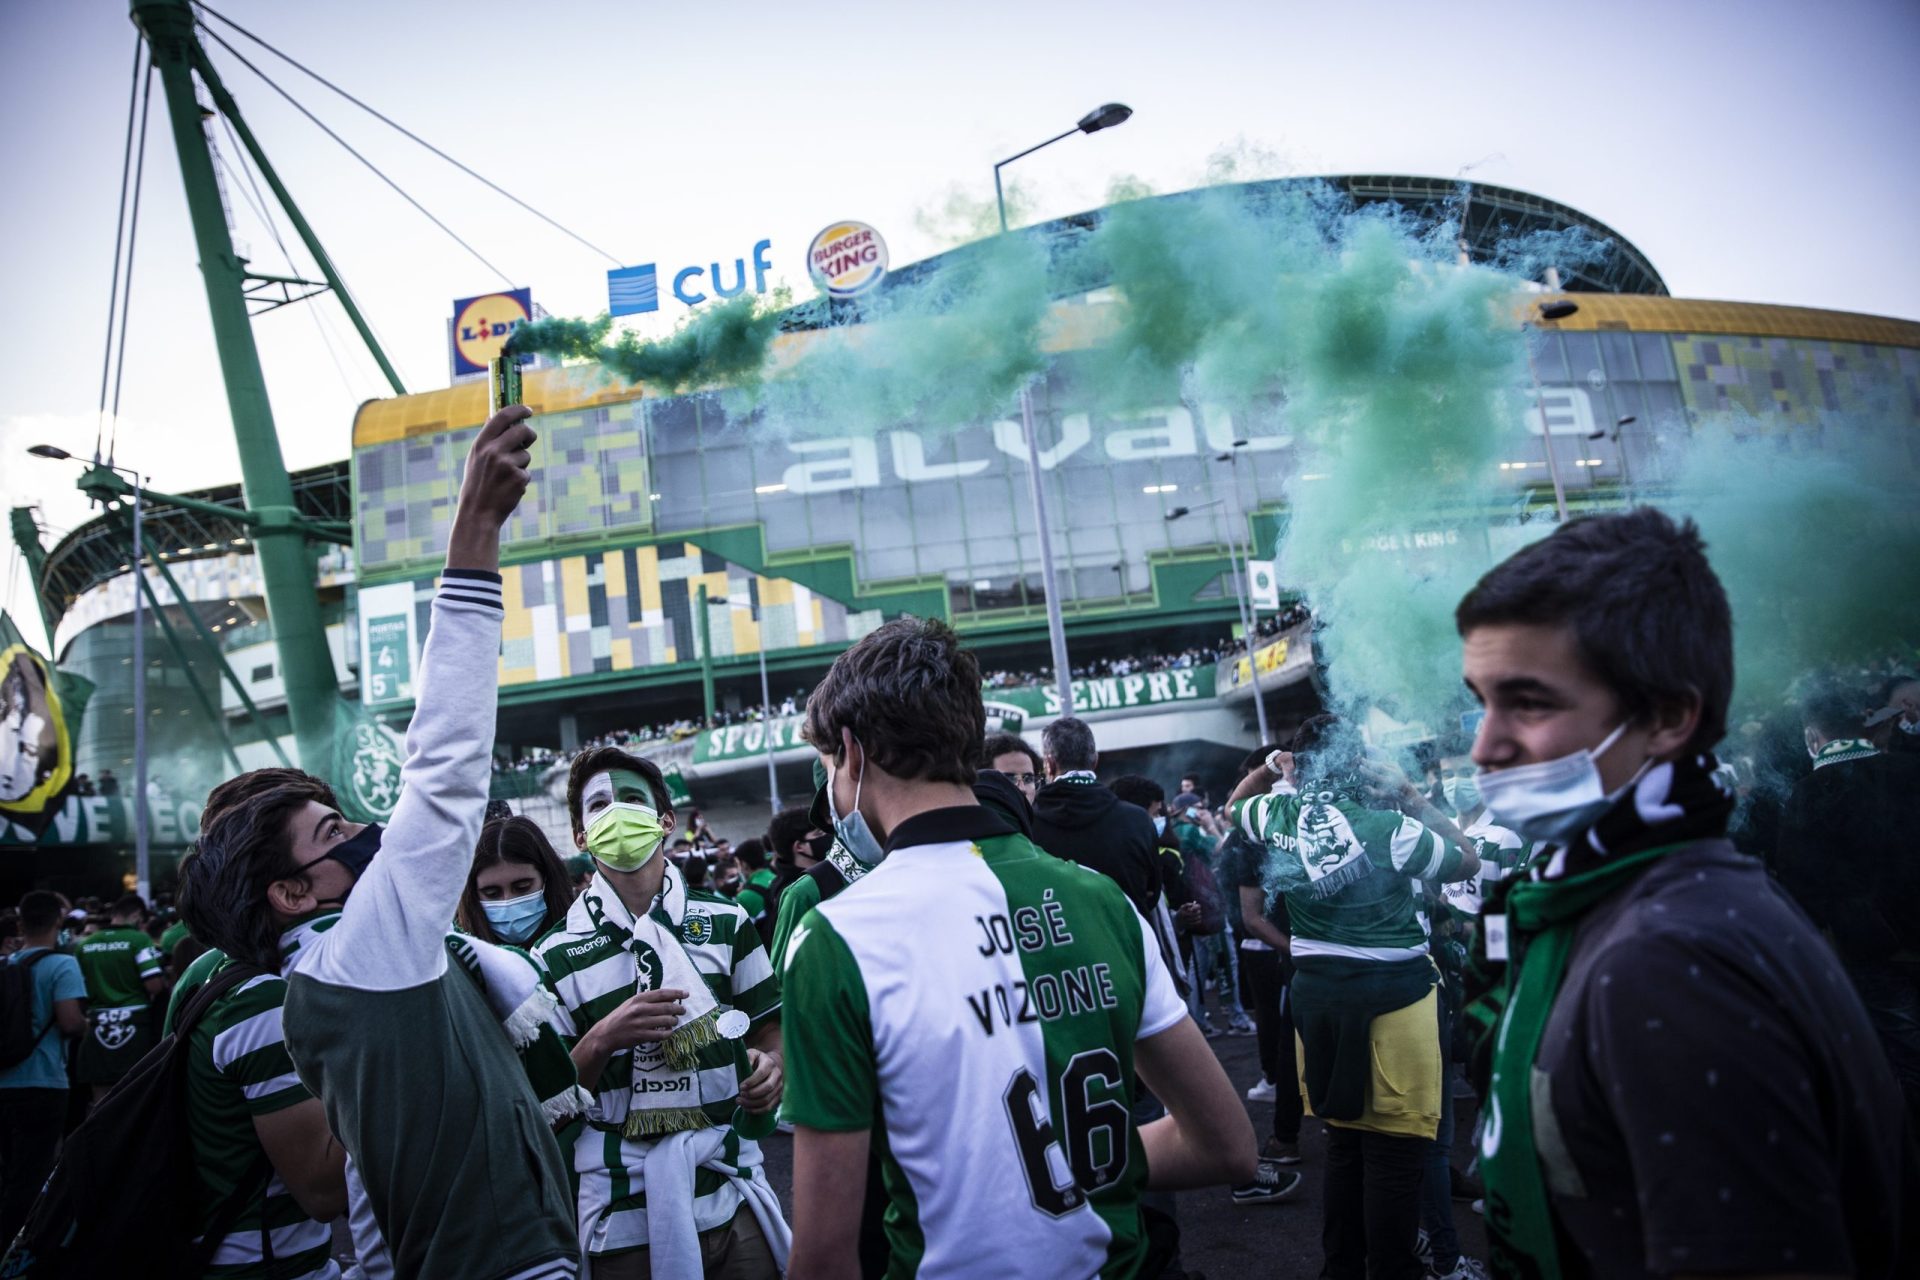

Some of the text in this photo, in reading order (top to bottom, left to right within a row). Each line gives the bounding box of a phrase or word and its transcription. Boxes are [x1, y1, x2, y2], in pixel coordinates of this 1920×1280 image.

[813, 229, 873, 264] BURGER
[821, 244, 878, 279] KING
[673, 239, 772, 305] cuf
[1414, 529, 1458, 549] KING
[378, 645, 393, 668] 4
[372, 674, 386, 697] 5
[1041, 667, 1198, 714] SEMPRE
[974, 888, 1074, 958] JOSÉ
[565, 935, 612, 957] macron
[964, 962, 1118, 1037] VOZONE
[1001, 1047, 1129, 1220] 66
